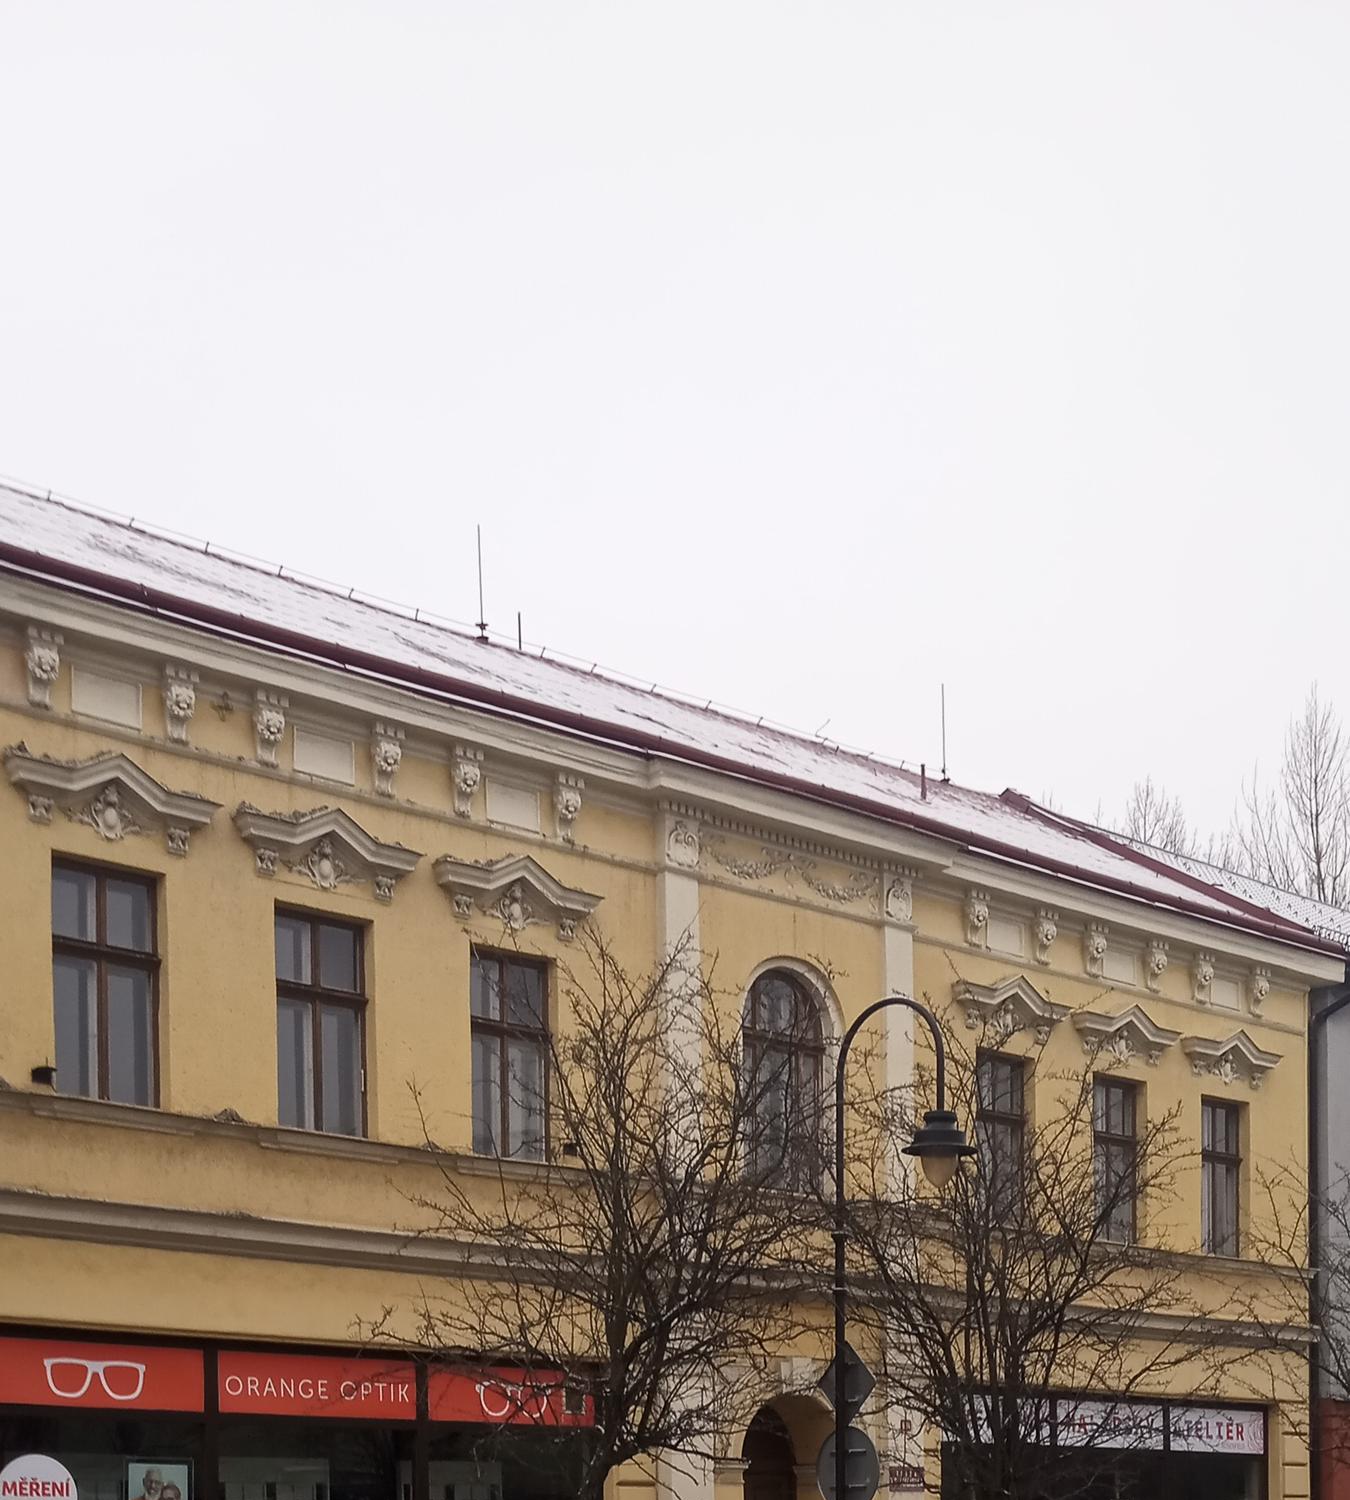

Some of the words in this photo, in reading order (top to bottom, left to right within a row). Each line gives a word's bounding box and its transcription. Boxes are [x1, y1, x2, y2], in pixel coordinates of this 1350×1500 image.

[225, 1375, 329, 1400] ORANGE
[340, 1380, 409, 1403] OPTIK
[2, 1477, 70, 1497] MĚŘENÍ
